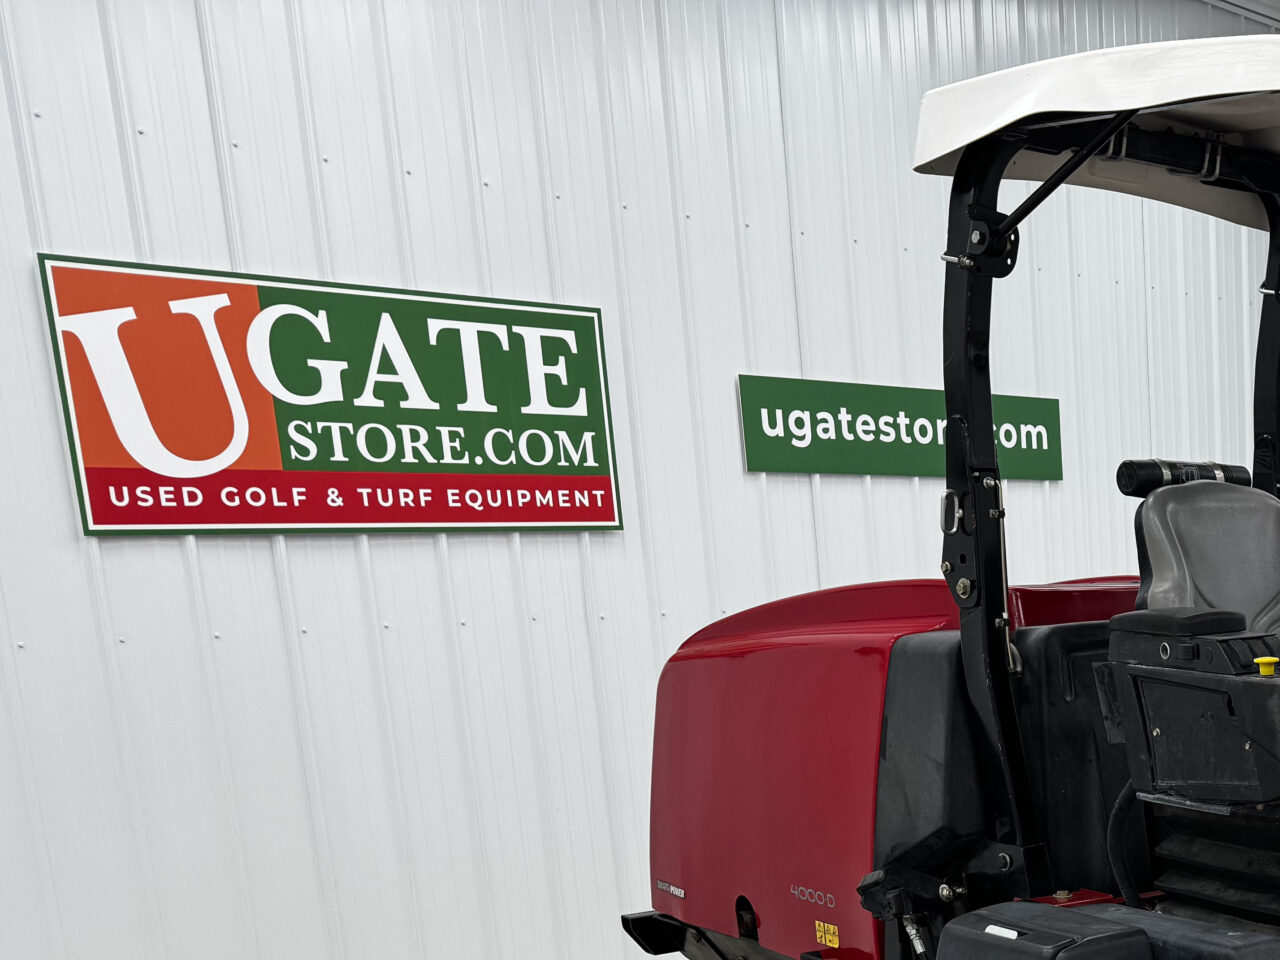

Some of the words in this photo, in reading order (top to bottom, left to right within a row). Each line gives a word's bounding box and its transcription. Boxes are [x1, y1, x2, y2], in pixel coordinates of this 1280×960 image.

[286, 419, 600, 467] STORE.COM
[760, 407, 1049, 450] ugatestorom
[108, 485, 204, 508] USED
[220, 486, 308, 508] GOLF
[326, 486, 344, 508] &
[357, 487, 433, 509] TURF
[447, 489, 606, 511] EQUIPMENT
